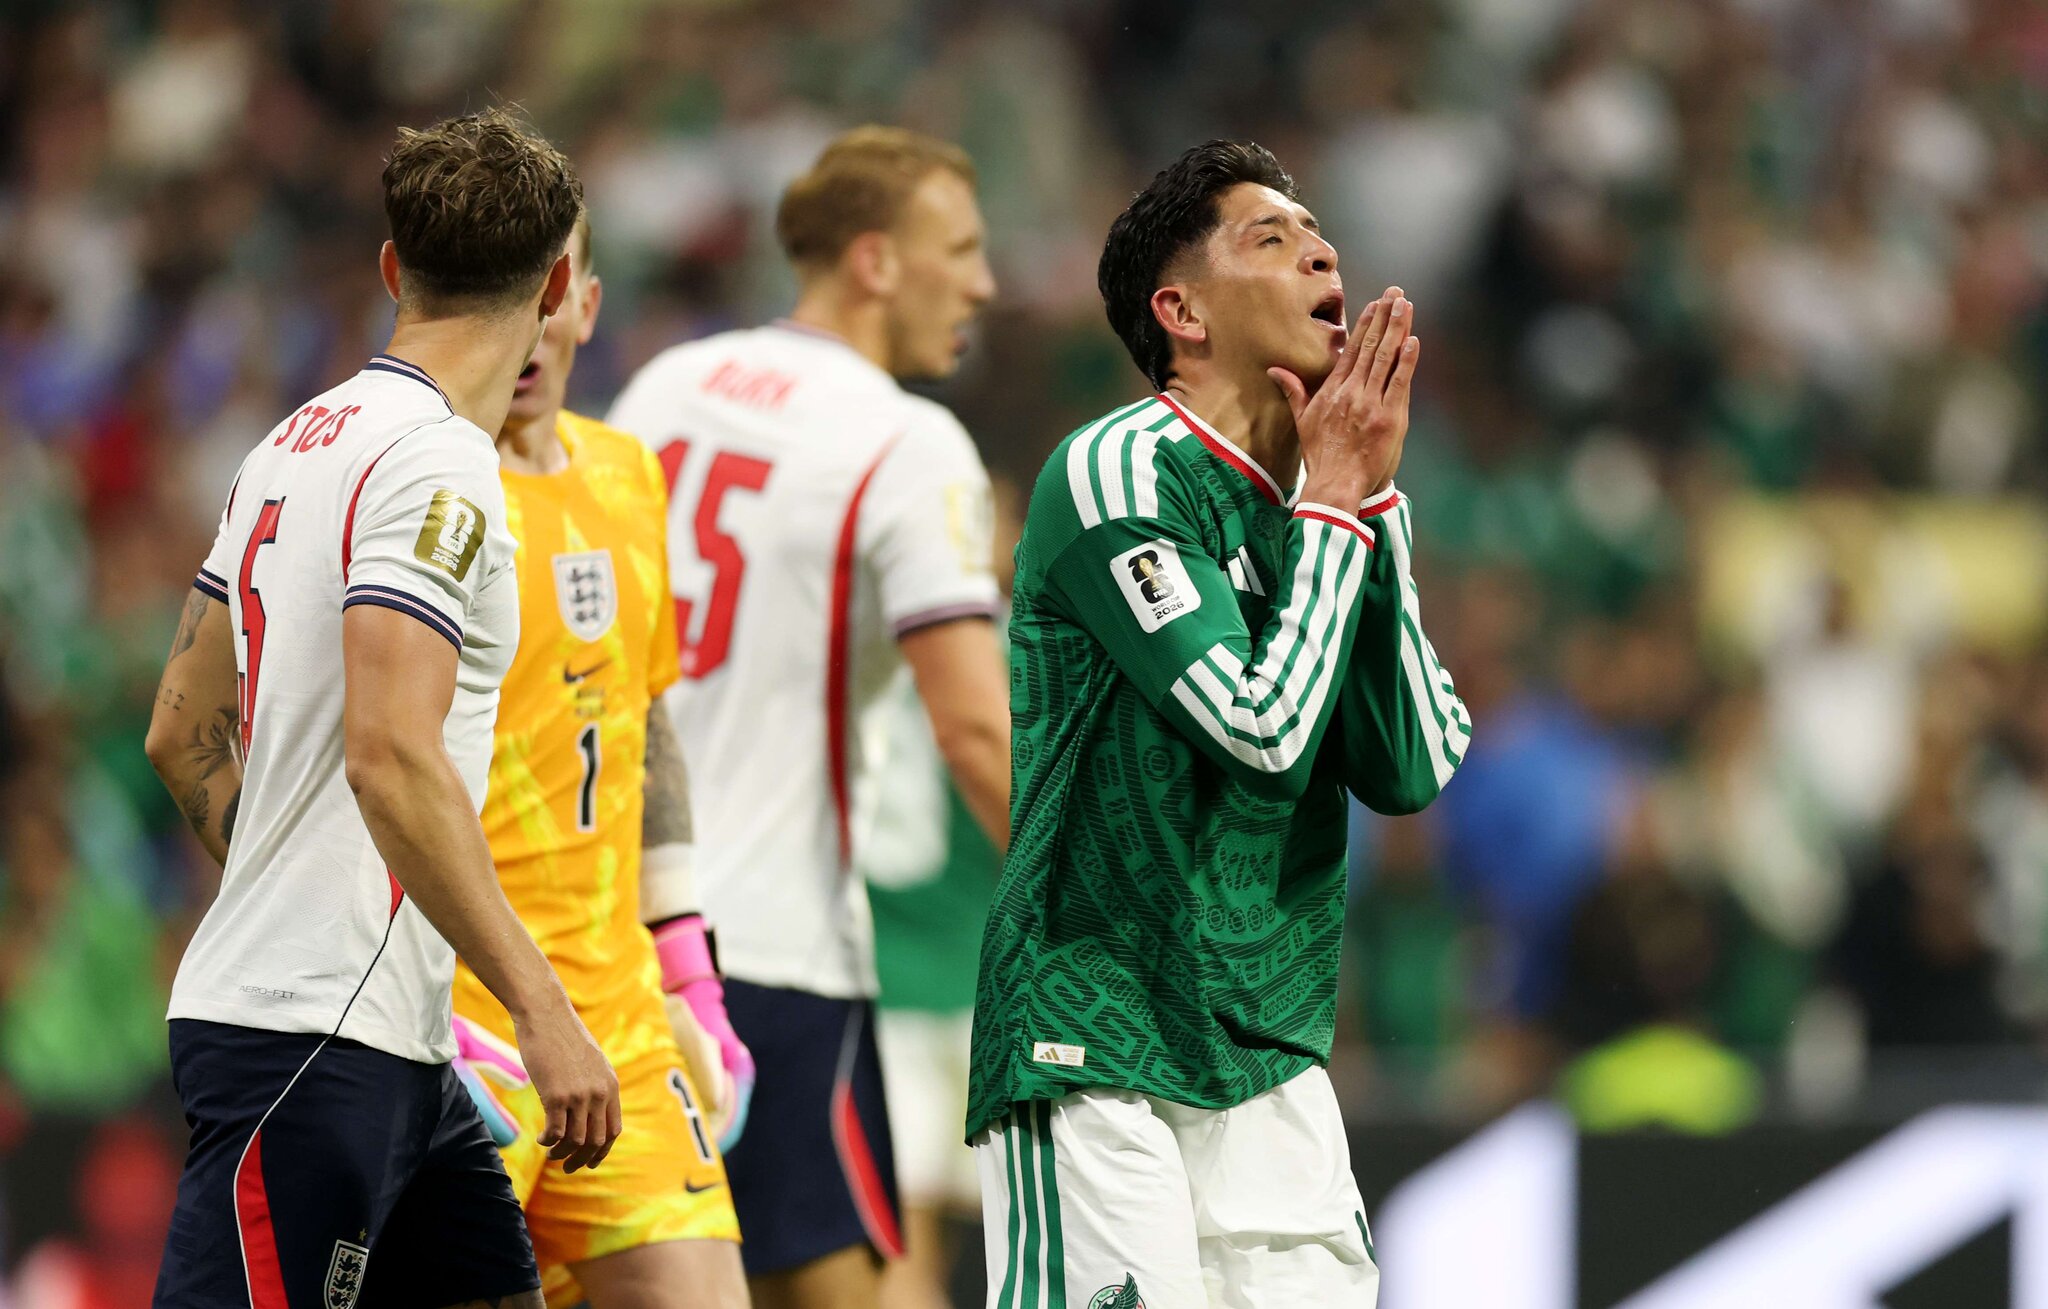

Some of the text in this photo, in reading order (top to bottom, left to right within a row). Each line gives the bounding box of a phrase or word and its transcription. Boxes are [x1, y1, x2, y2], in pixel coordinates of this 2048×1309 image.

[238, 496, 286, 765] 5
[1151, 600, 1170, 612] WORLD
[1155, 601, 1184, 620] 2026
[577, 722, 601, 833] 1
[239, 984, 296, 999] AERO-FIT
[666, 1068, 715, 1165] 1
